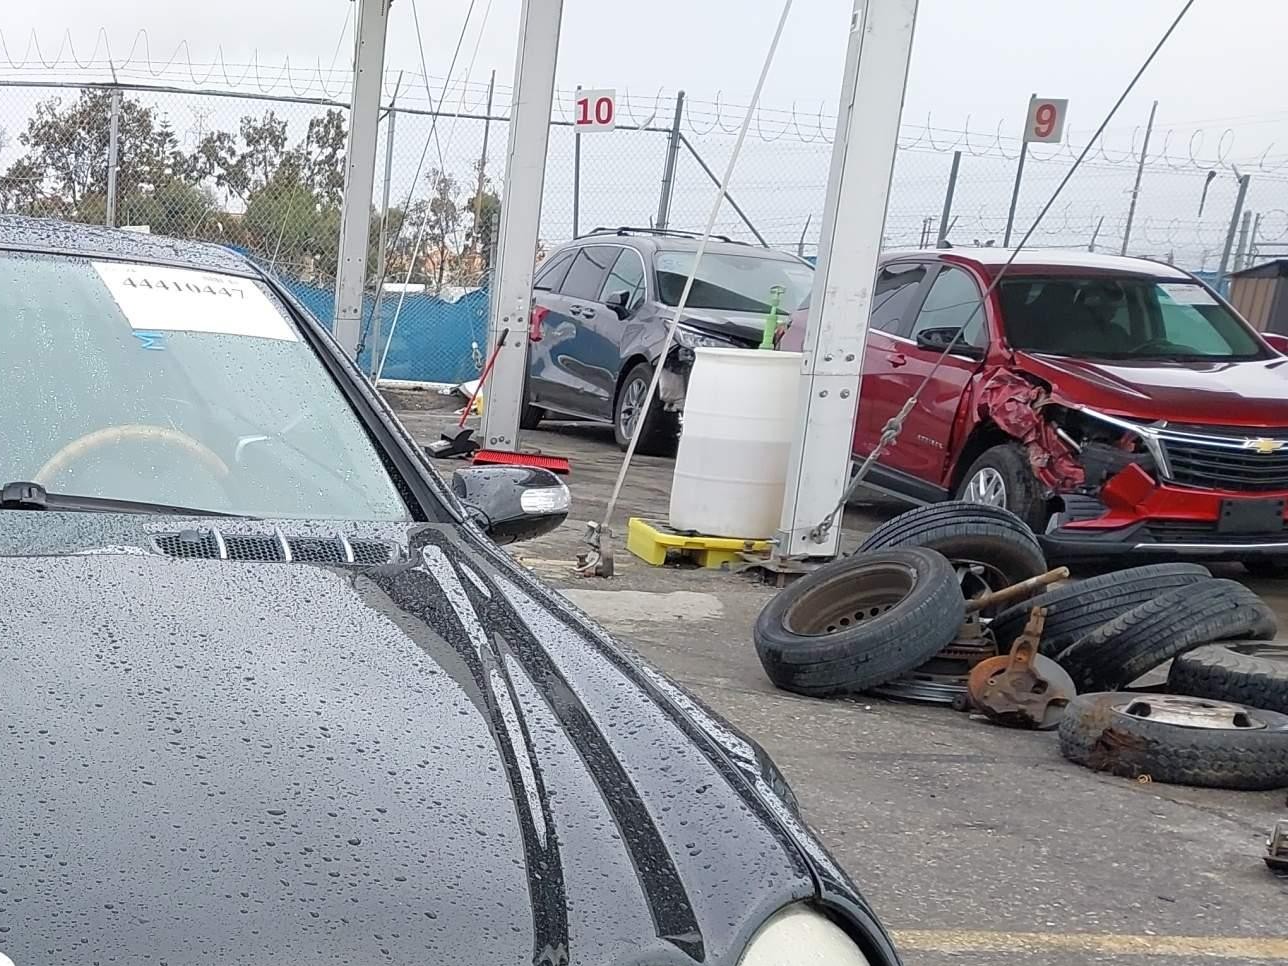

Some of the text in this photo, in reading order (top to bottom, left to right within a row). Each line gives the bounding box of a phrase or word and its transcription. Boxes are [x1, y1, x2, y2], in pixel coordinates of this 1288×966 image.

[576, 97, 613, 125] 10
[1034, 103, 1057, 138] 9
[122, 277, 245, 299] 44410447
